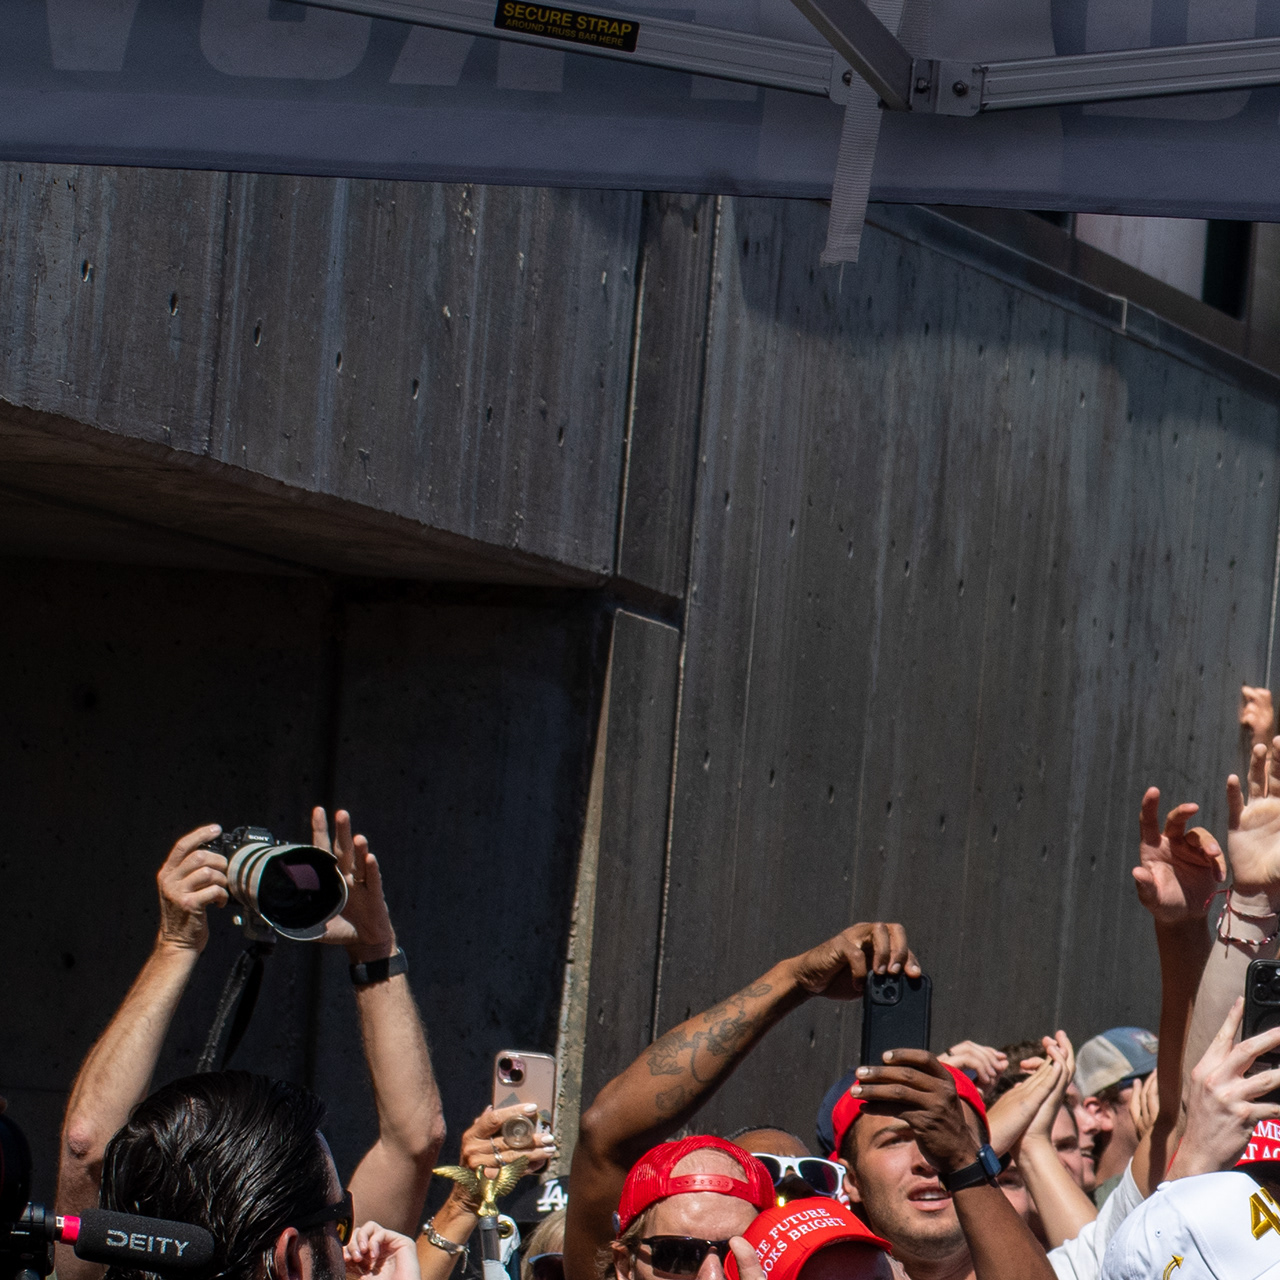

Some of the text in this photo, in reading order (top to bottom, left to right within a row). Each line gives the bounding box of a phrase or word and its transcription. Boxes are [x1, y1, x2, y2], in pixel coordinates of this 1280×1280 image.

[503, 2, 632, 37] SECURE STRAP
[505, 18, 625, 48] AROUND TRUSS BAR HERE
[768, 1208, 830, 1240] FUTURE
[787, 1217, 846, 1242] BRIGHT
[106, 1229, 190, 1257] DEITY
